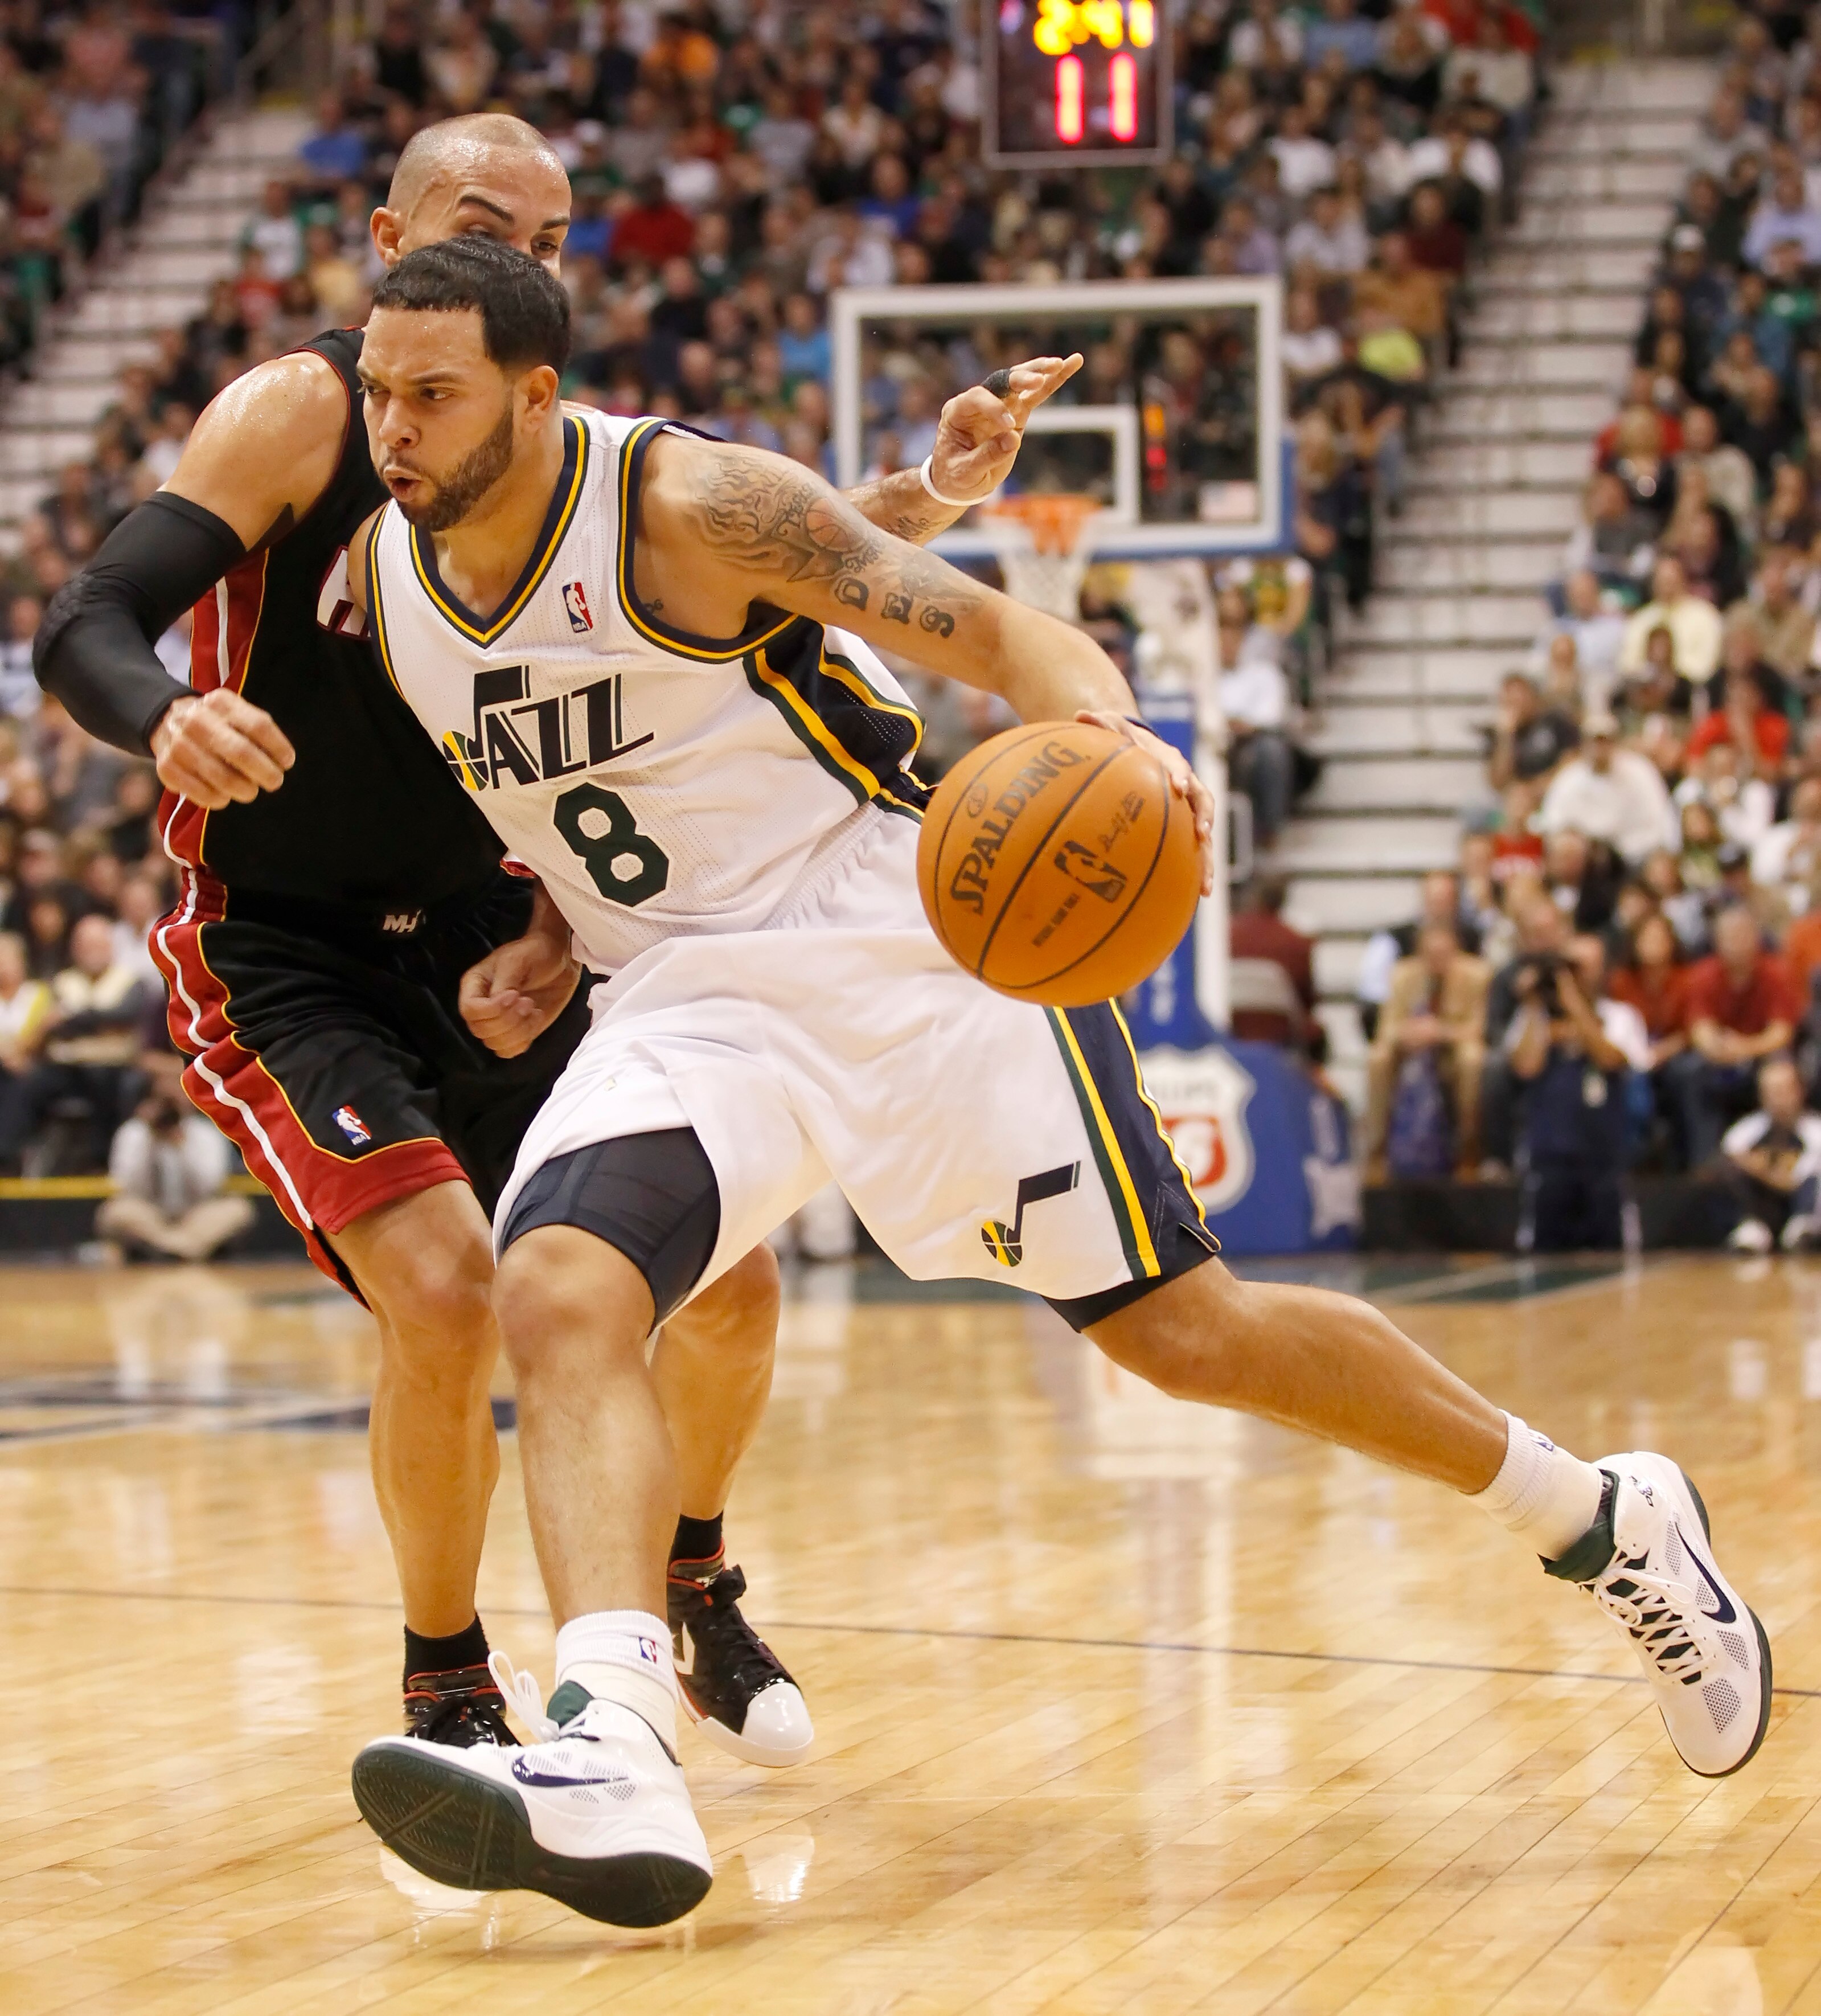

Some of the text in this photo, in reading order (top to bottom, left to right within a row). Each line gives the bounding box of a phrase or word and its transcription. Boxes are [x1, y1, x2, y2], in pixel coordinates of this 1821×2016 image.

[1055, 52, 1138, 145] 11
[442, 665, 655, 792] JAZZ
[553, 781, 670, 908] 8
[949, 741, 1084, 916] SPALDING
